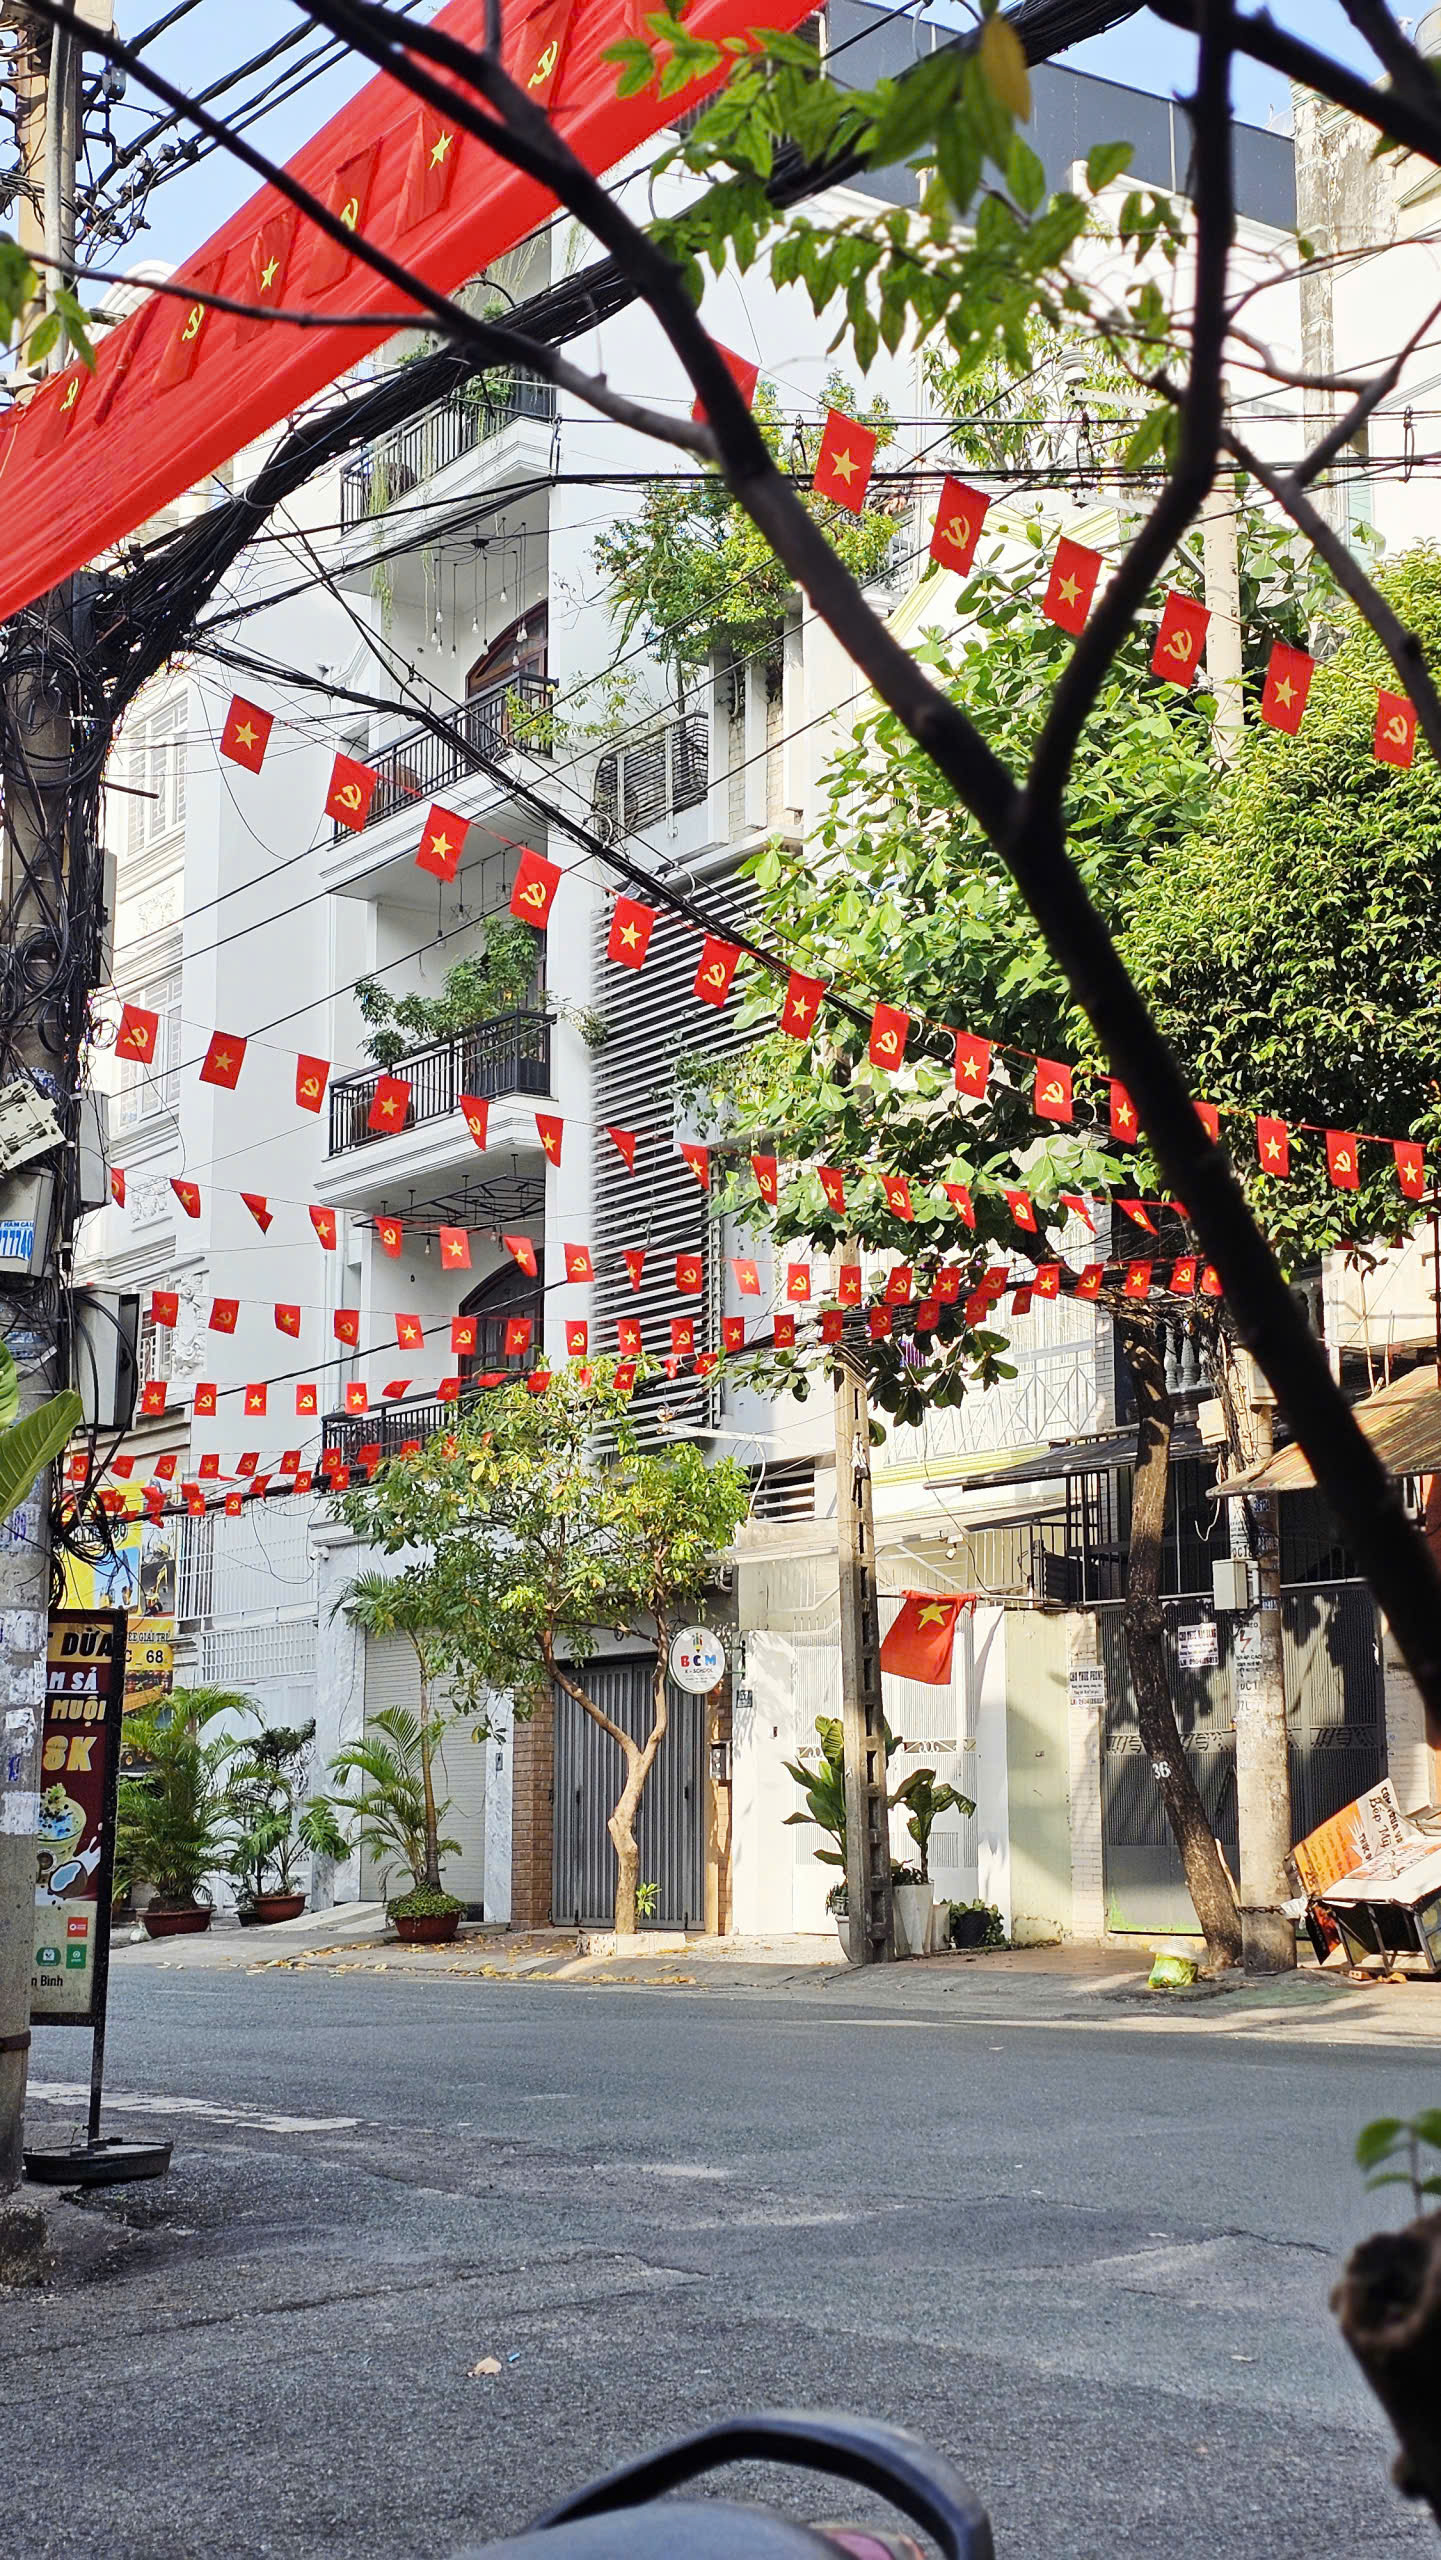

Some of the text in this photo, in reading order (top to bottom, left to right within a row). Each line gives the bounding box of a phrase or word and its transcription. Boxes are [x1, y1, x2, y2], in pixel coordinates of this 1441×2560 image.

[0, 1230, 33, 1260] 77740
[146, 1650, 163, 1663] 68
[681, 1655, 716, 1667] BCM
[1152, 1761, 1171, 1780] 36
